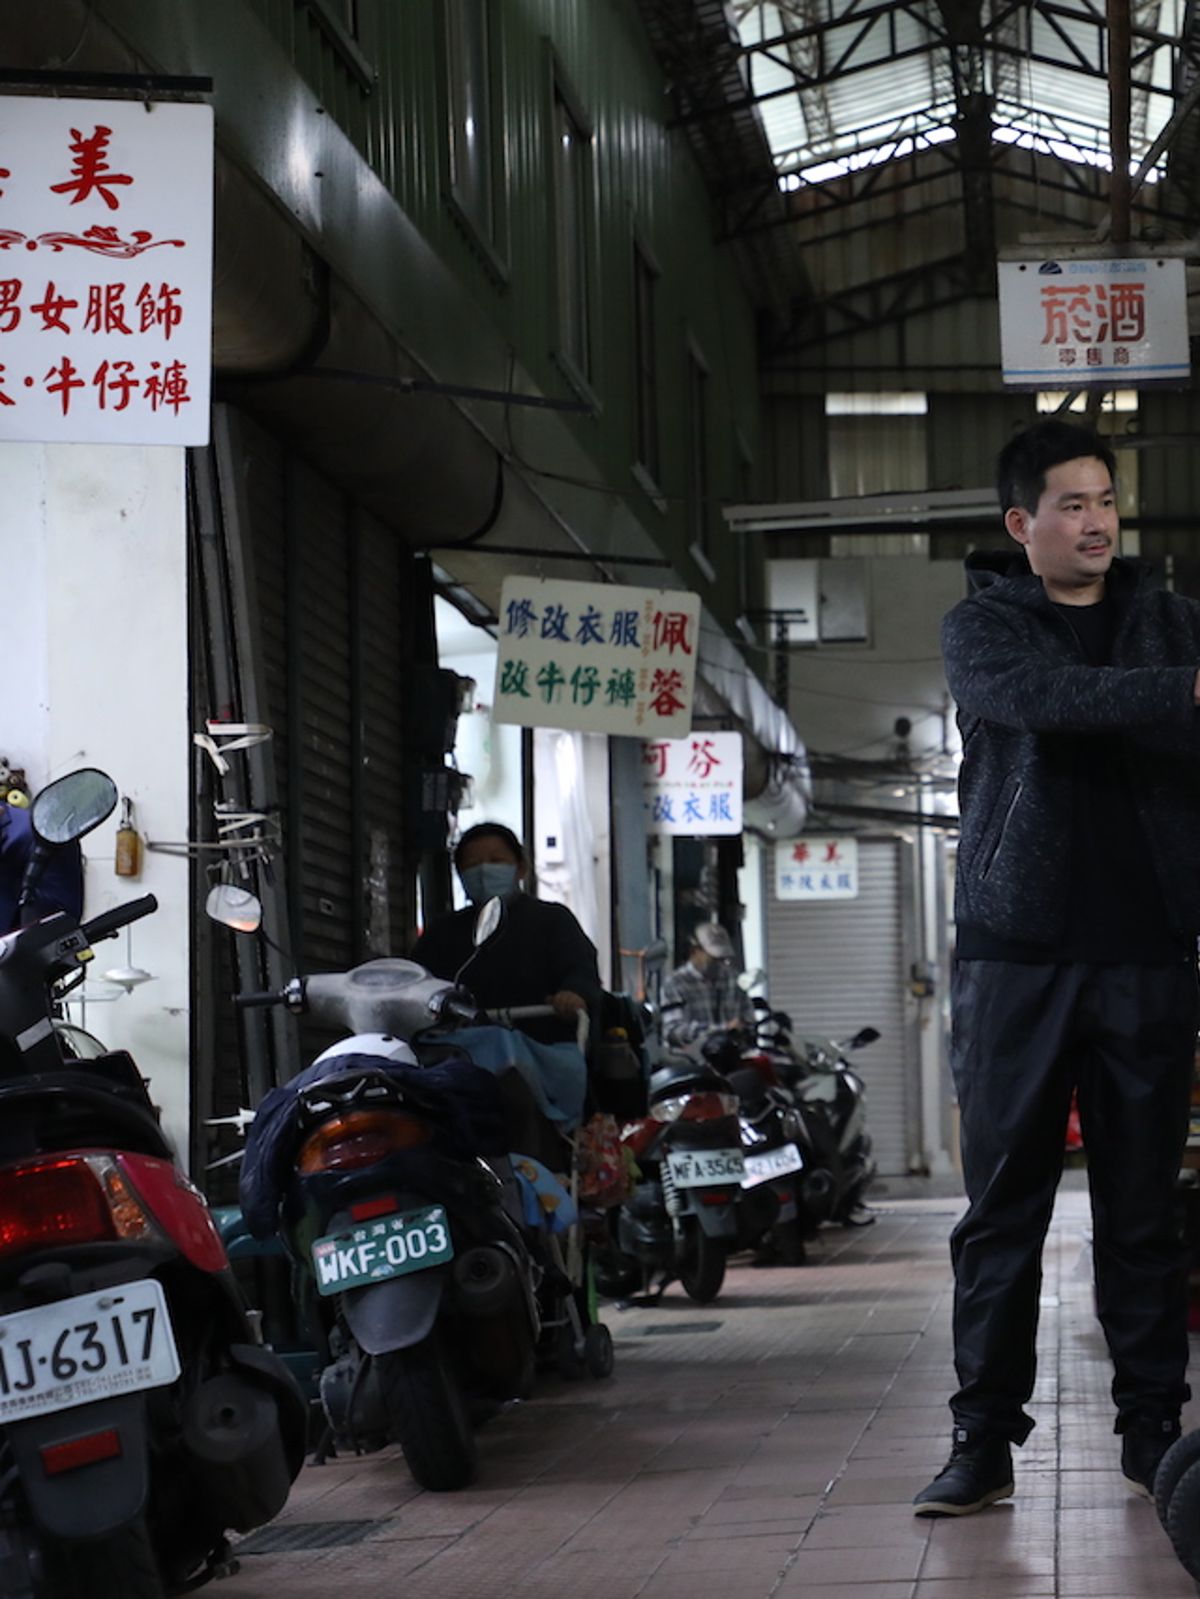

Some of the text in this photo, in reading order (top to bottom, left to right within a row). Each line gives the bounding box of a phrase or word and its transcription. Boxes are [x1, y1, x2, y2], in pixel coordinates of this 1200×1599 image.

[0, 125, 134, 210] 美
[1041, 283, 1146, 344] 菸酒
[506, 598, 641, 649] 修改衣服
[500, 659, 638, 709] 改牛仔褲
[318, 1223, 448, 1285] WKF-003
